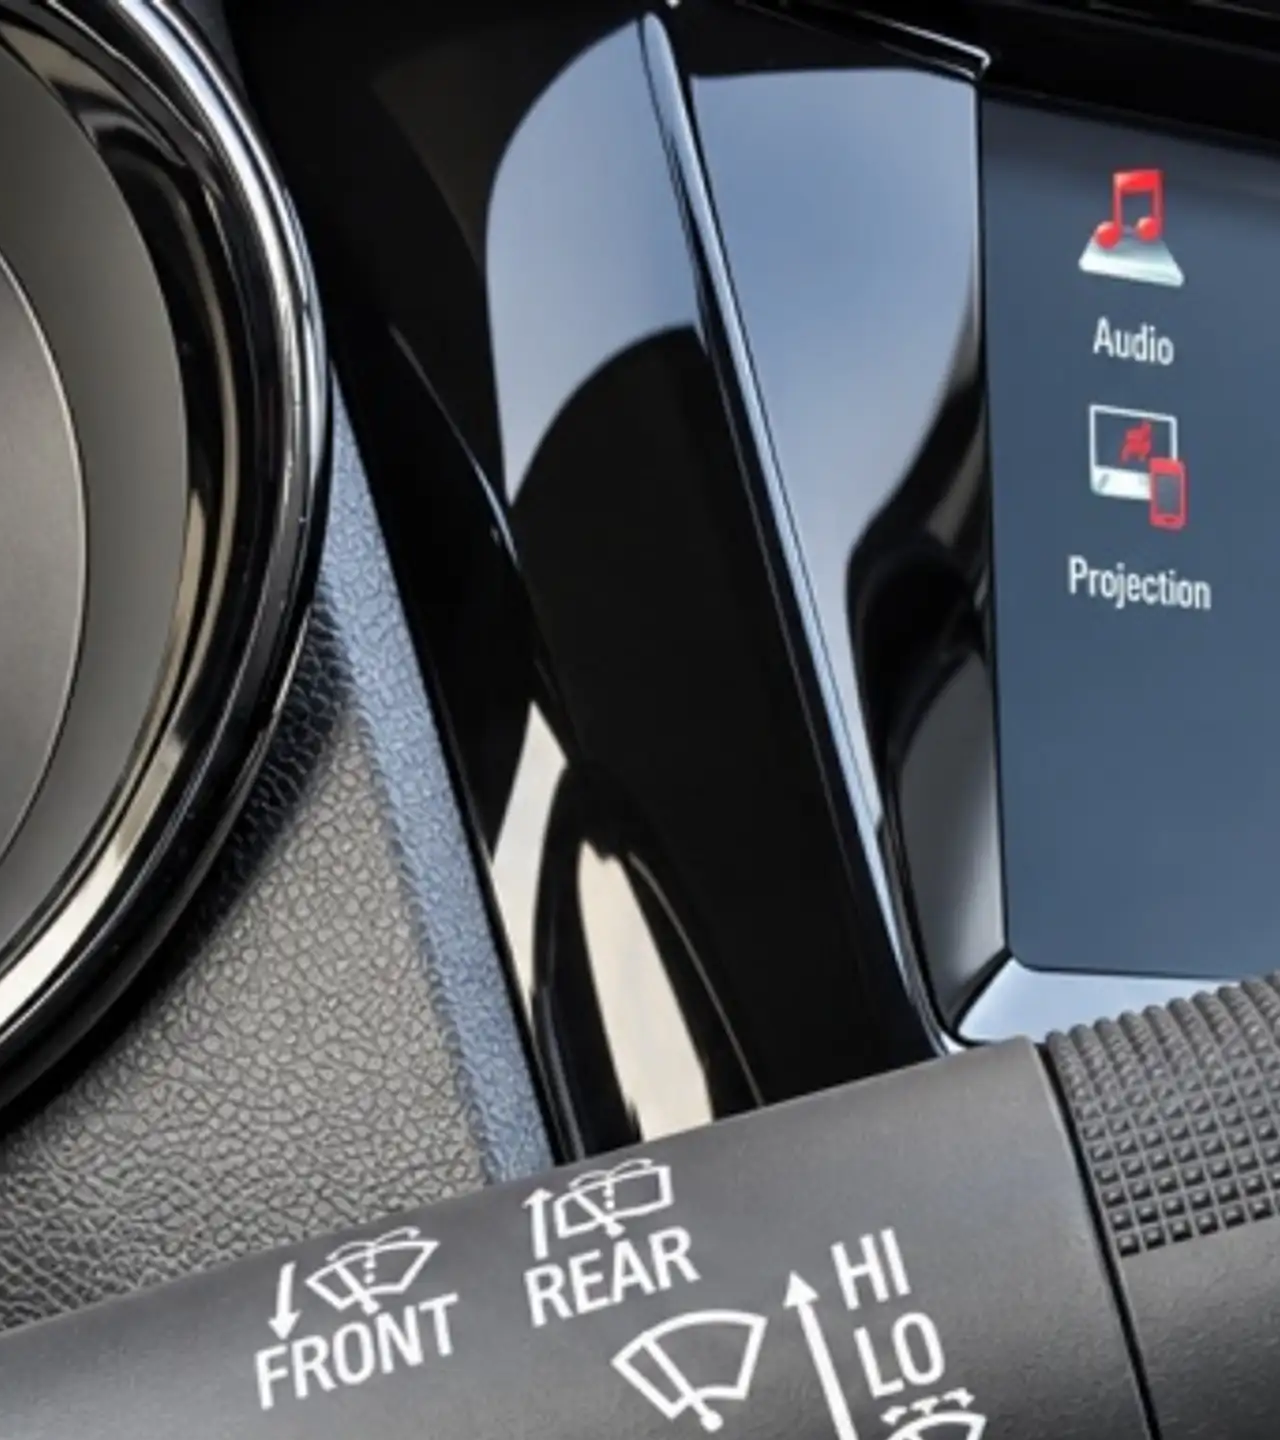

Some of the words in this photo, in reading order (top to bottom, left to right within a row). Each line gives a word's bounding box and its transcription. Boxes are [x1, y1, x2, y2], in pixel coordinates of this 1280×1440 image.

[1093, 318, 1174, 364] Audio
[1068, 556, 1211, 610] Projection
[524, 1226, 701, 1327] REAR
[831, 1228, 911, 1311] HI
[254, 1292, 459, 1411] FRONT
[853, 1312, 945, 1399] LO
